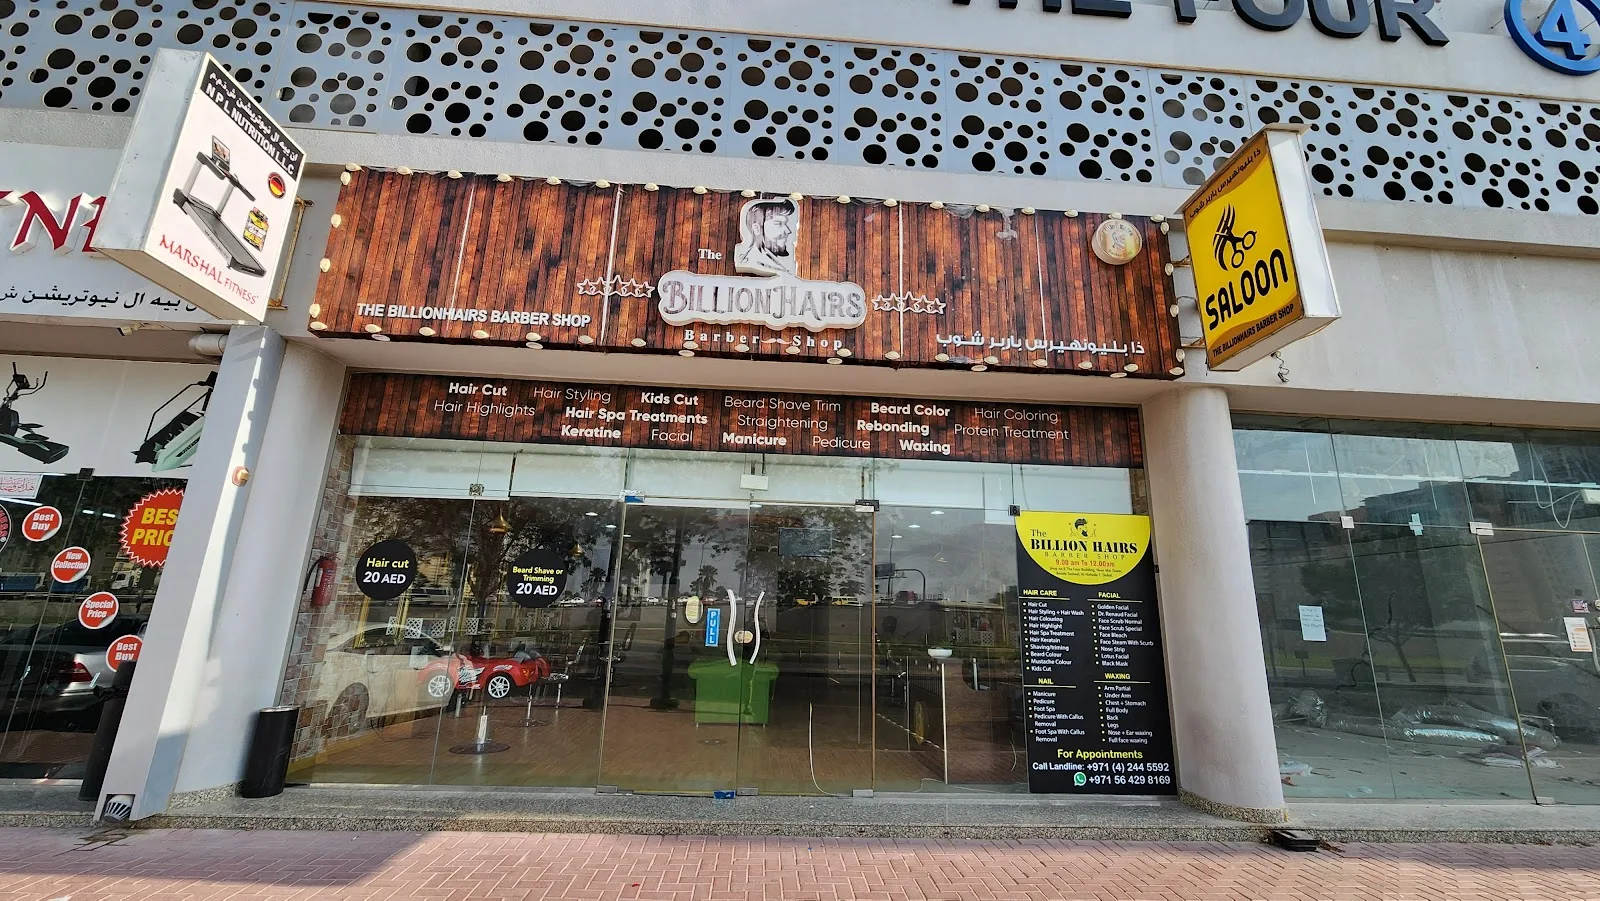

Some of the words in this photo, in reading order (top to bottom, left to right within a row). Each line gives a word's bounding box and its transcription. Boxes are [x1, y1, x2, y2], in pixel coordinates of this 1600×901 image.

[231, 107, 276, 157] NUTRITION
[160, 234, 223, 284] MARSHAL
[698, 248, 722, 260] The
[22, 285, 119, 308] نيوتريشن
[1205, 248, 1289, 331] SALOON
[124, 292, 146, 308] ال
[356, 303, 385, 317] THE
[387, 304, 487, 323] BILLIONHAIRS
[490, 310, 549, 326] BARBER
[551, 313, 591, 328] SHOP
[1212, 346, 1222, 357] THE
[1223, 326, 1256, 352] BILLIONHAIRS
[1256, 313, 1278, 332] BARBER
[1278, 303, 1294, 319] SHOP
[684, 329, 760, 345] Barber
[792, 335, 842, 350] Shop
[936, 330, 985, 348] شوب
[988, 334, 1022, 351] باربر
[1131, 340, 1145, 354] ذا
[449, 382, 478, 395] Hair
[481, 384, 508, 396] Cut
[533, 387, 562, 399] Hair
[565, 388, 611, 404] Styling
[641, 392, 670, 405] Kids
[673, 394, 699, 406] Cut
[724, 396, 765, 409] Beard
[769, 398, 811, 411] Shave
[814, 400, 841, 412] Trim
[434, 400, 462, 412] Hair
[466, 402, 536, 418] Highlights
[565, 406, 595, 419] Hair
[597, 407, 625, 423] Spa
[629, 409, 708, 425] Treatments
[870, 402, 910, 415] Beard
[914, 404, 950, 417] Color
[974, 407, 1000, 419] Hair
[1003, 408, 1058, 424] Coloring
[737, 414, 828, 432] Straightening
[857, 419, 930, 437] Rebonding
[561, 425, 621, 439] Keratine
[651, 429, 693, 442] Facial
[954, 423, 999, 437] Protein
[1002, 425, 1069, 440] Treatment
[722, 432, 787, 446] Manicure
[812, 436, 871, 450] Pedicure
[899, 439, 951, 455] Waxing
[33, 512, 54, 521] Best
[141, 508, 179, 525] BES
[31, 522, 50, 531] Buy
[1030, 529, 1047, 537] The
[131, 528, 175, 546] PRIC
[1030, 539, 1087, 552] BILLION
[1093, 541, 1138, 554] HAIRS
[65, 551, 83, 560] New
[1044, 551, 1089, 559] BARBER
[54, 560, 88, 569] Collection
[366, 557, 390, 568] Hair
[392, 559, 409, 569] cut
[363, 571, 380, 583] 20
[381, 573, 406, 584] AED
[512, 566, 533, 574] Beard
[534, 567, 554, 575] Shave
[523, 574, 555, 584] Trimming
[516, 582, 532, 594] 20
[533, 585, 558, 595] AED
[85, 600, 114, 609] Special
[86, 609, 107, 618] Price
[708, 611, 718, 644] PULL
[116, 642, 138, 651] Best
[1057, 749, 1074, 758] For
[1075, 749, 1144, 760] Appointments
[1032, 762, 1048, 770] Call
[1049, 763, 1085, 771] Landline:
[1086, 763, 1109, 772] +971
[1112, 763, 1125, 773] (4)
[1127, 763, 1144, 772] 244
[1146, 763, 1169, 772] 5592
[1089, 775, 1111, 784] +971
[1114, 775, 1126, 784] 56
[1128, 775, 1145, 784] 429
[1147, 775, 1170, 784] 8169
